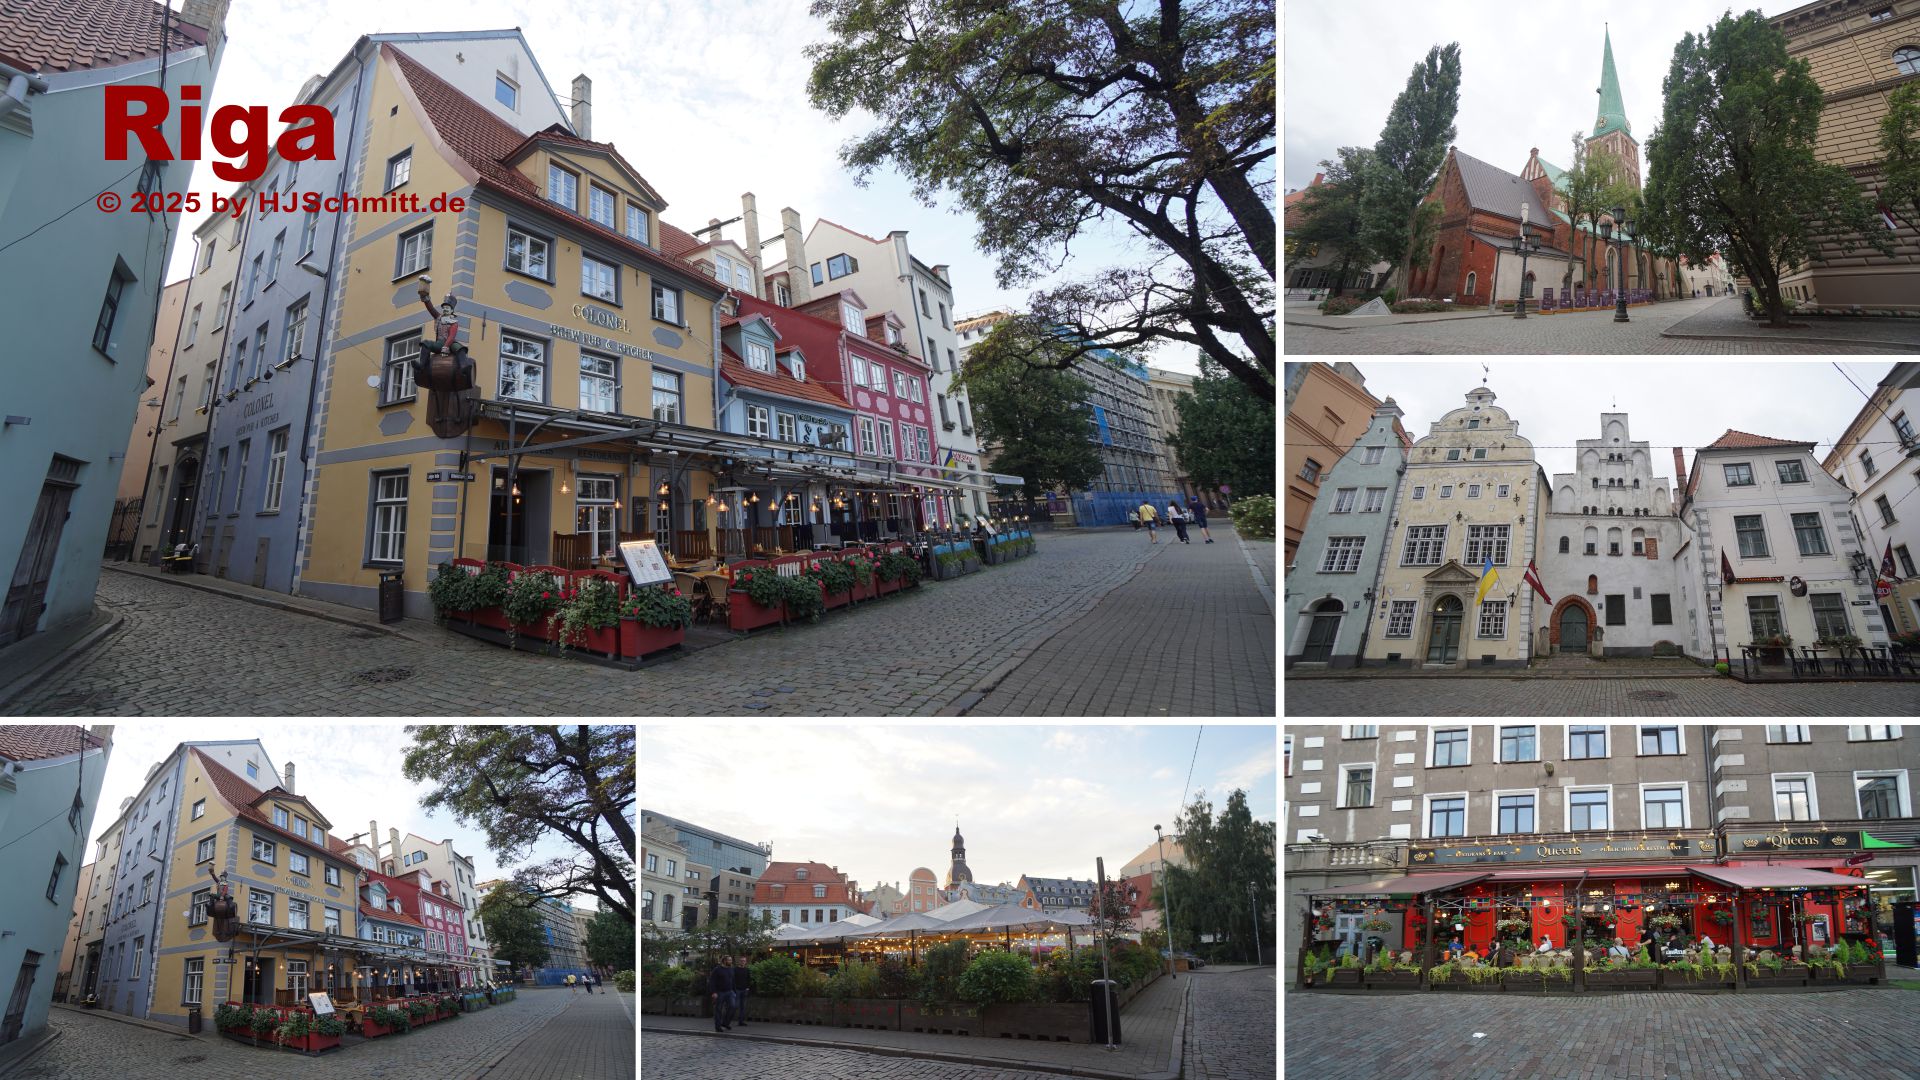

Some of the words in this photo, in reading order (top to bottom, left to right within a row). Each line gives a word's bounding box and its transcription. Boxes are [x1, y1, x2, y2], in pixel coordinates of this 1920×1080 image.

[572, 304, 631, 333] COLONEL
[551, 324, 581, 342] BREW
[1771, 834, 1819, 848] Queens
[1537, 845, 1582, 858] Queens
